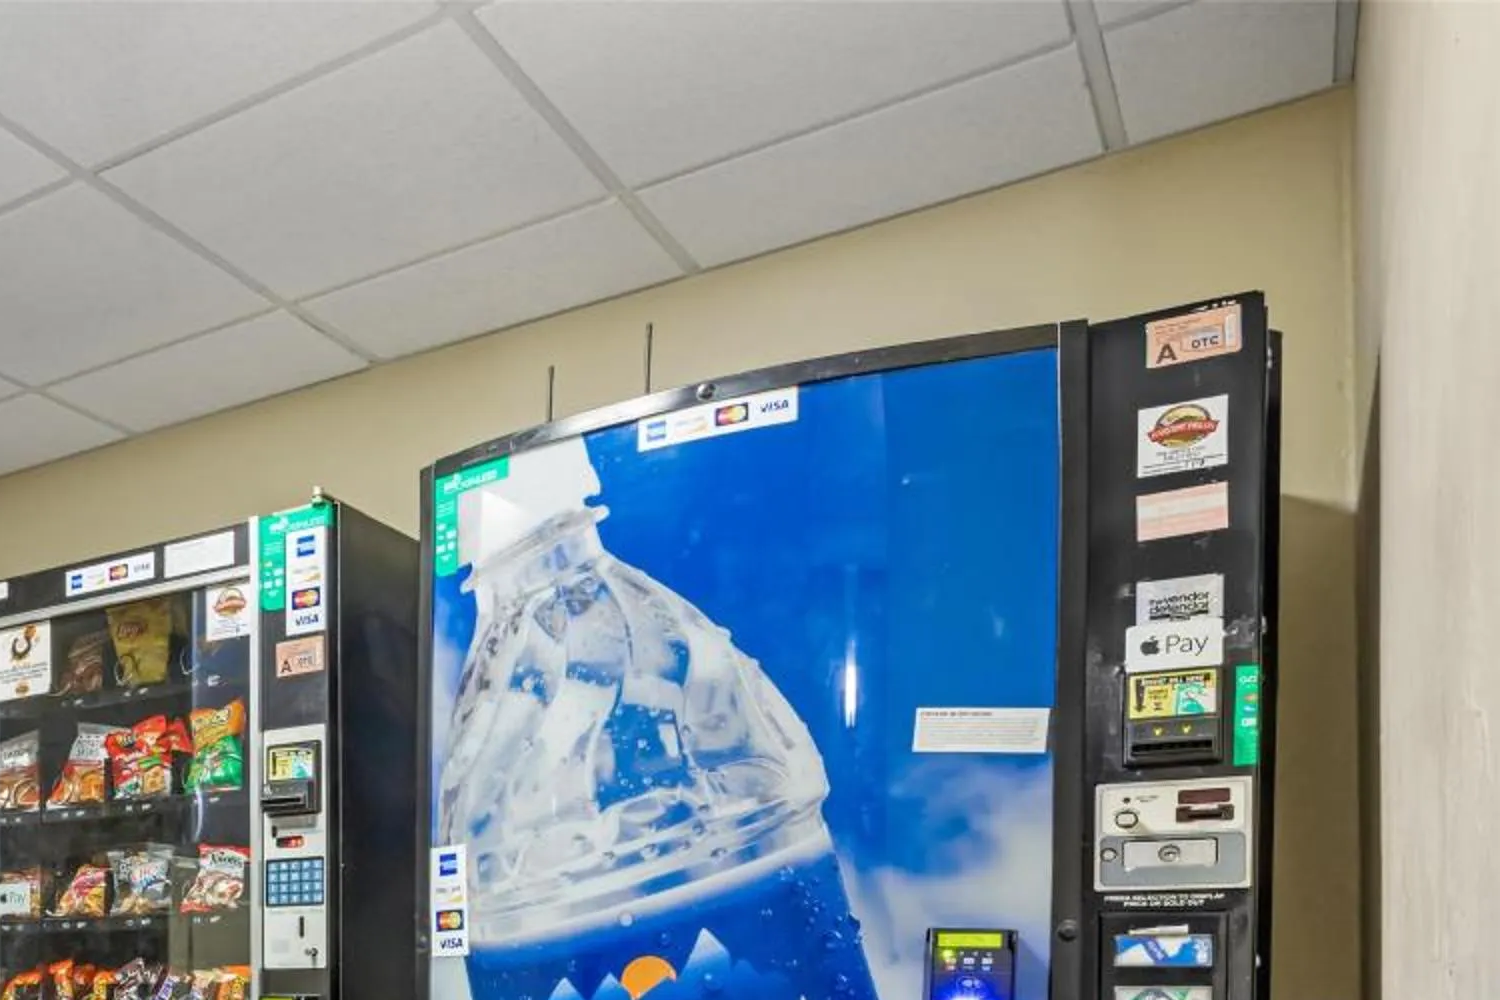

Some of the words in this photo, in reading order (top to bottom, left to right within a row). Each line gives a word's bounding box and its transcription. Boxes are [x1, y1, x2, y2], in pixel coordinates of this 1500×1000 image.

[1155, 343, 1178, 365] A
[1190, 335, 1220, 349] OTC
[760, 399, 789, 413] VISA
[295, 613, 319, 626] VISA
[1165, 634, 1209, 656] Pay
[281, 660, 293, 674] A
[440, 937, 463, 949] VISA
